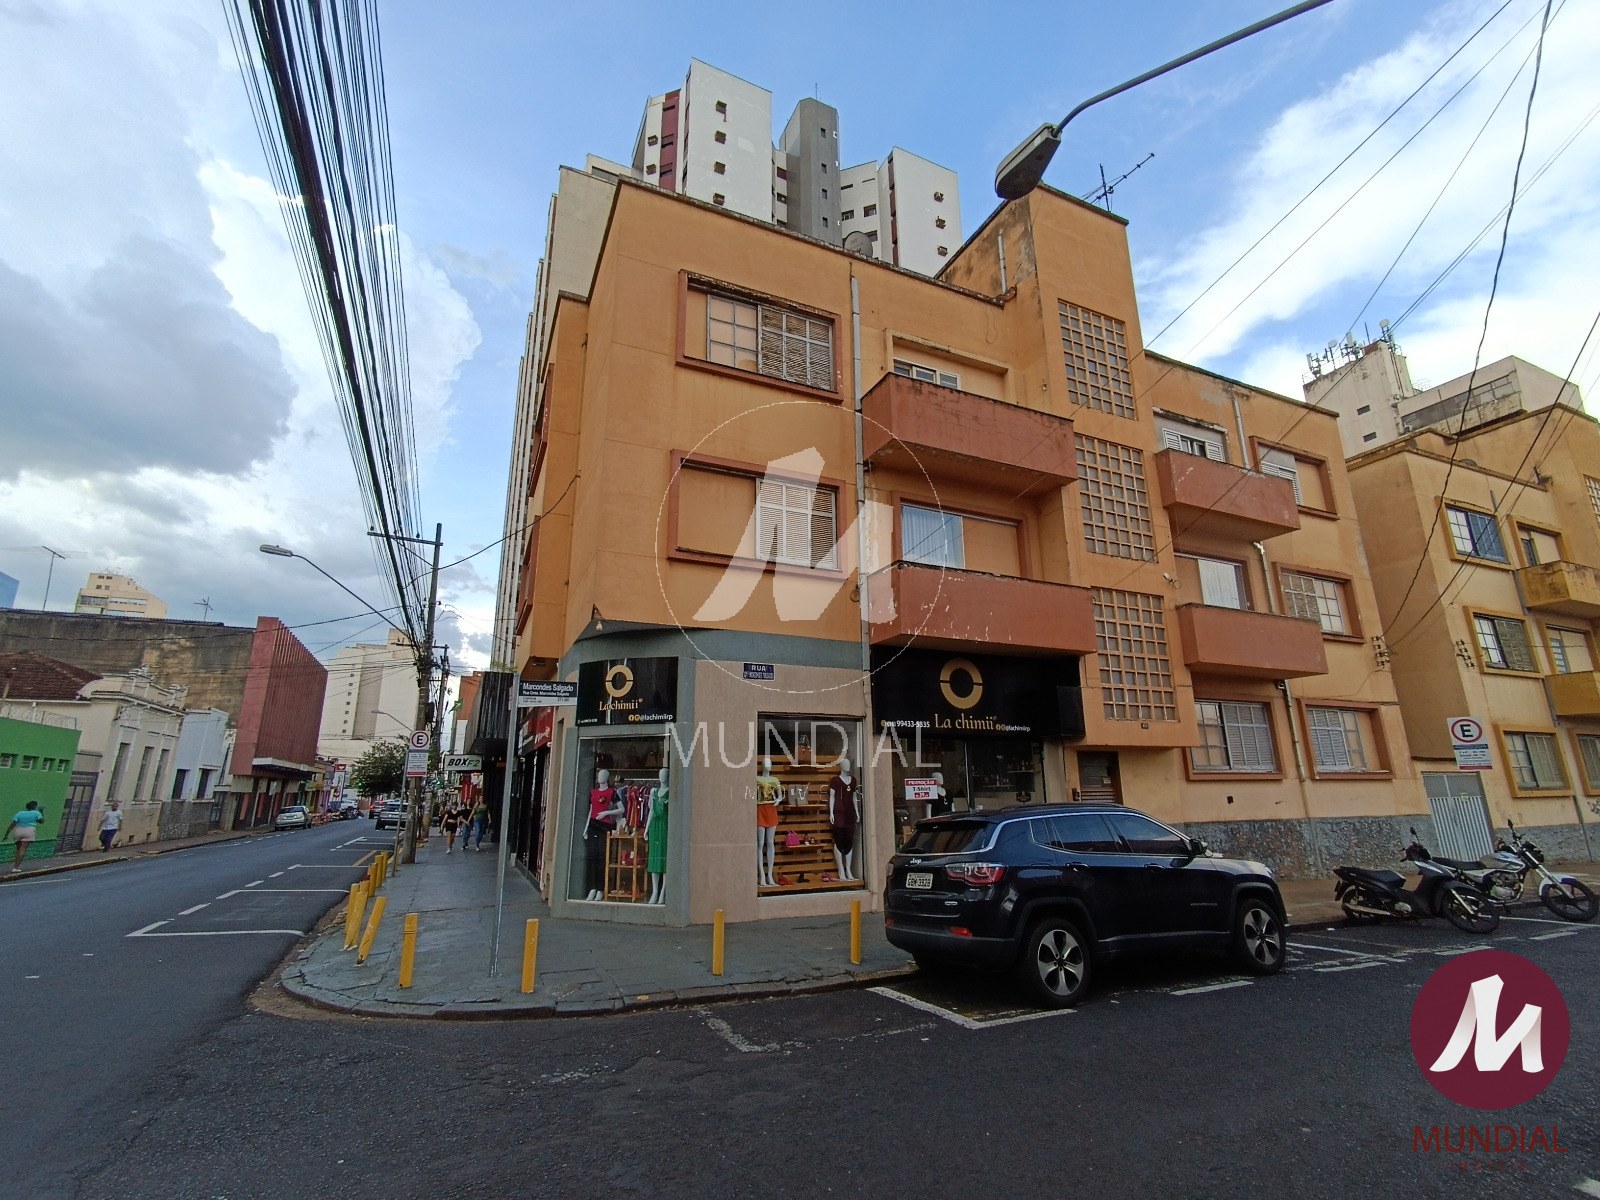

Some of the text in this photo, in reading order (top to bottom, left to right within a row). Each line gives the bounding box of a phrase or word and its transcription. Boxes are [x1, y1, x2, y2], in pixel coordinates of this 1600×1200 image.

[751, 664, 767, 672] RUA
[522, 683, 574, 693] Marcondes Salgado
[935, 713, 994, 730] La chimii
[1459, 724, 1474, 738] E
[416, 735, 424, 745] E
